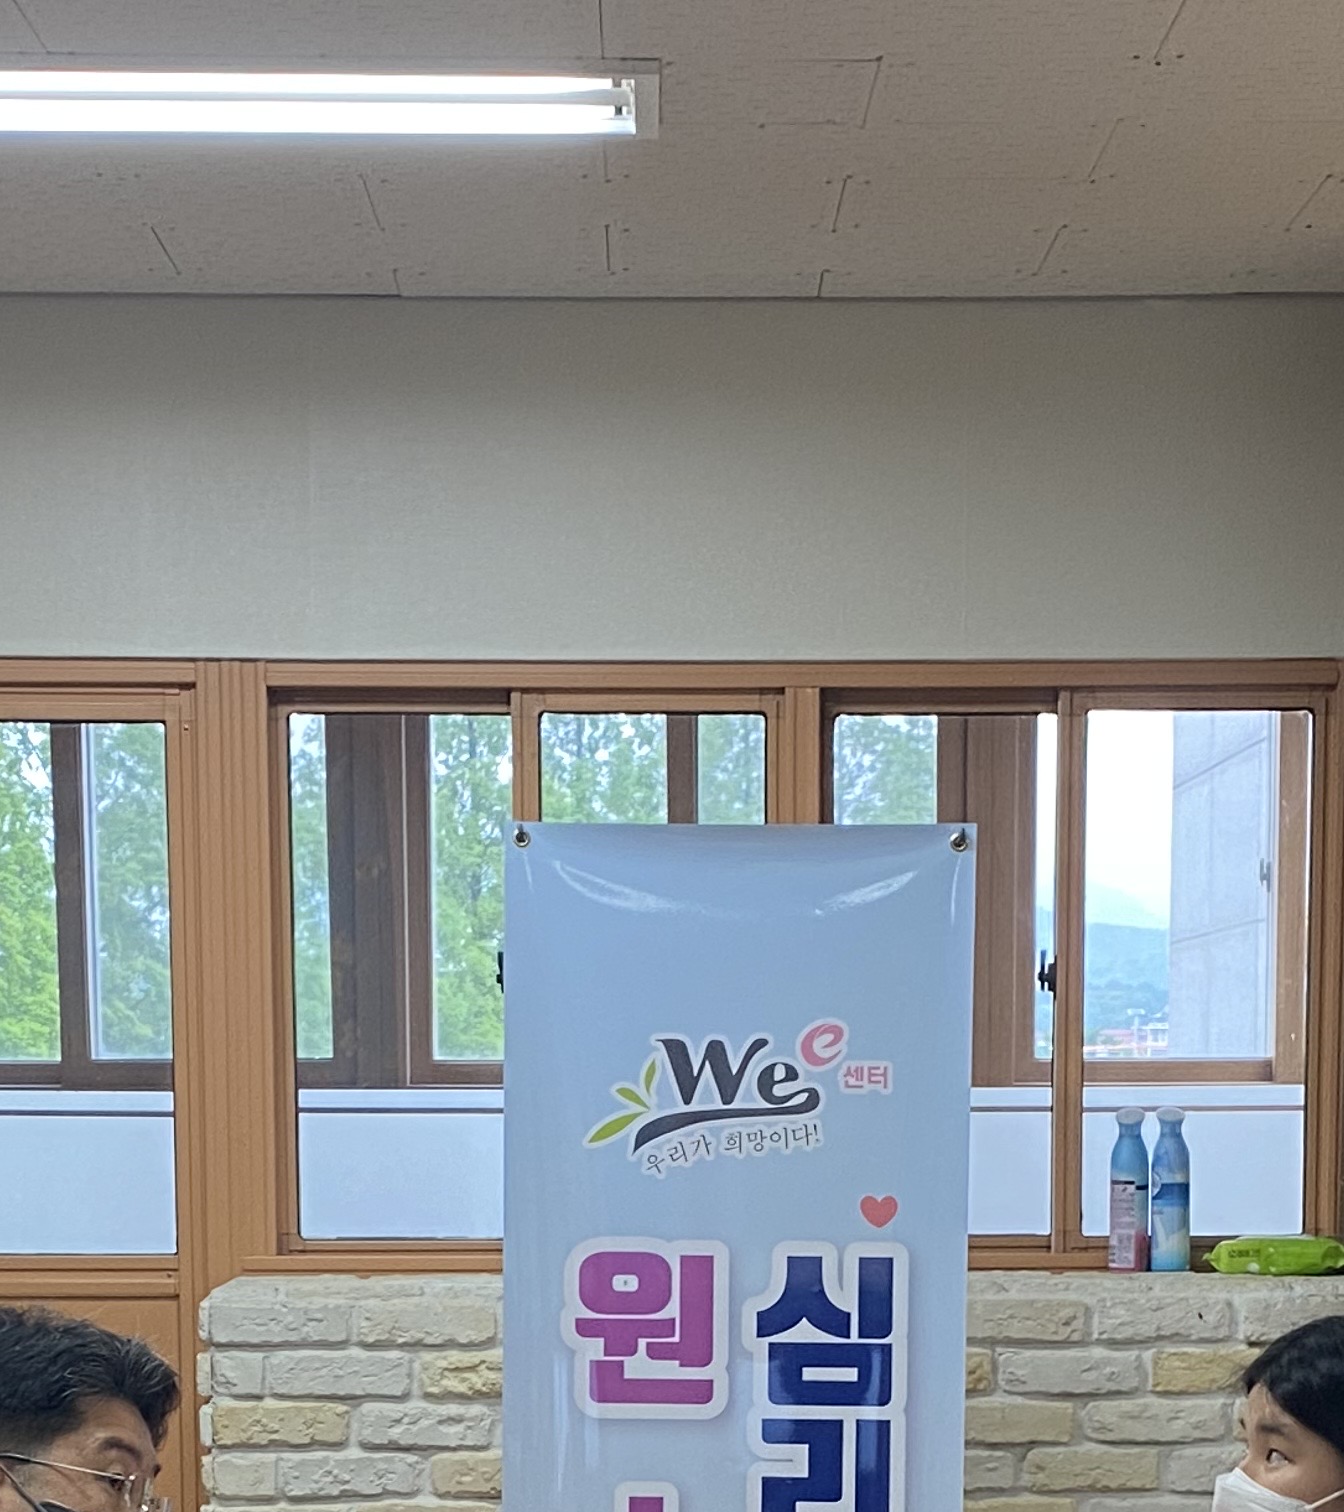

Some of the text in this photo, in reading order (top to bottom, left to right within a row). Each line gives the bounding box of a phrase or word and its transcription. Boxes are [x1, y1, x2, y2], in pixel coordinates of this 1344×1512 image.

[842, 1065, 889, 1090] 센터
[645, 1123, 821, 1174] 우리가 희망이다!
